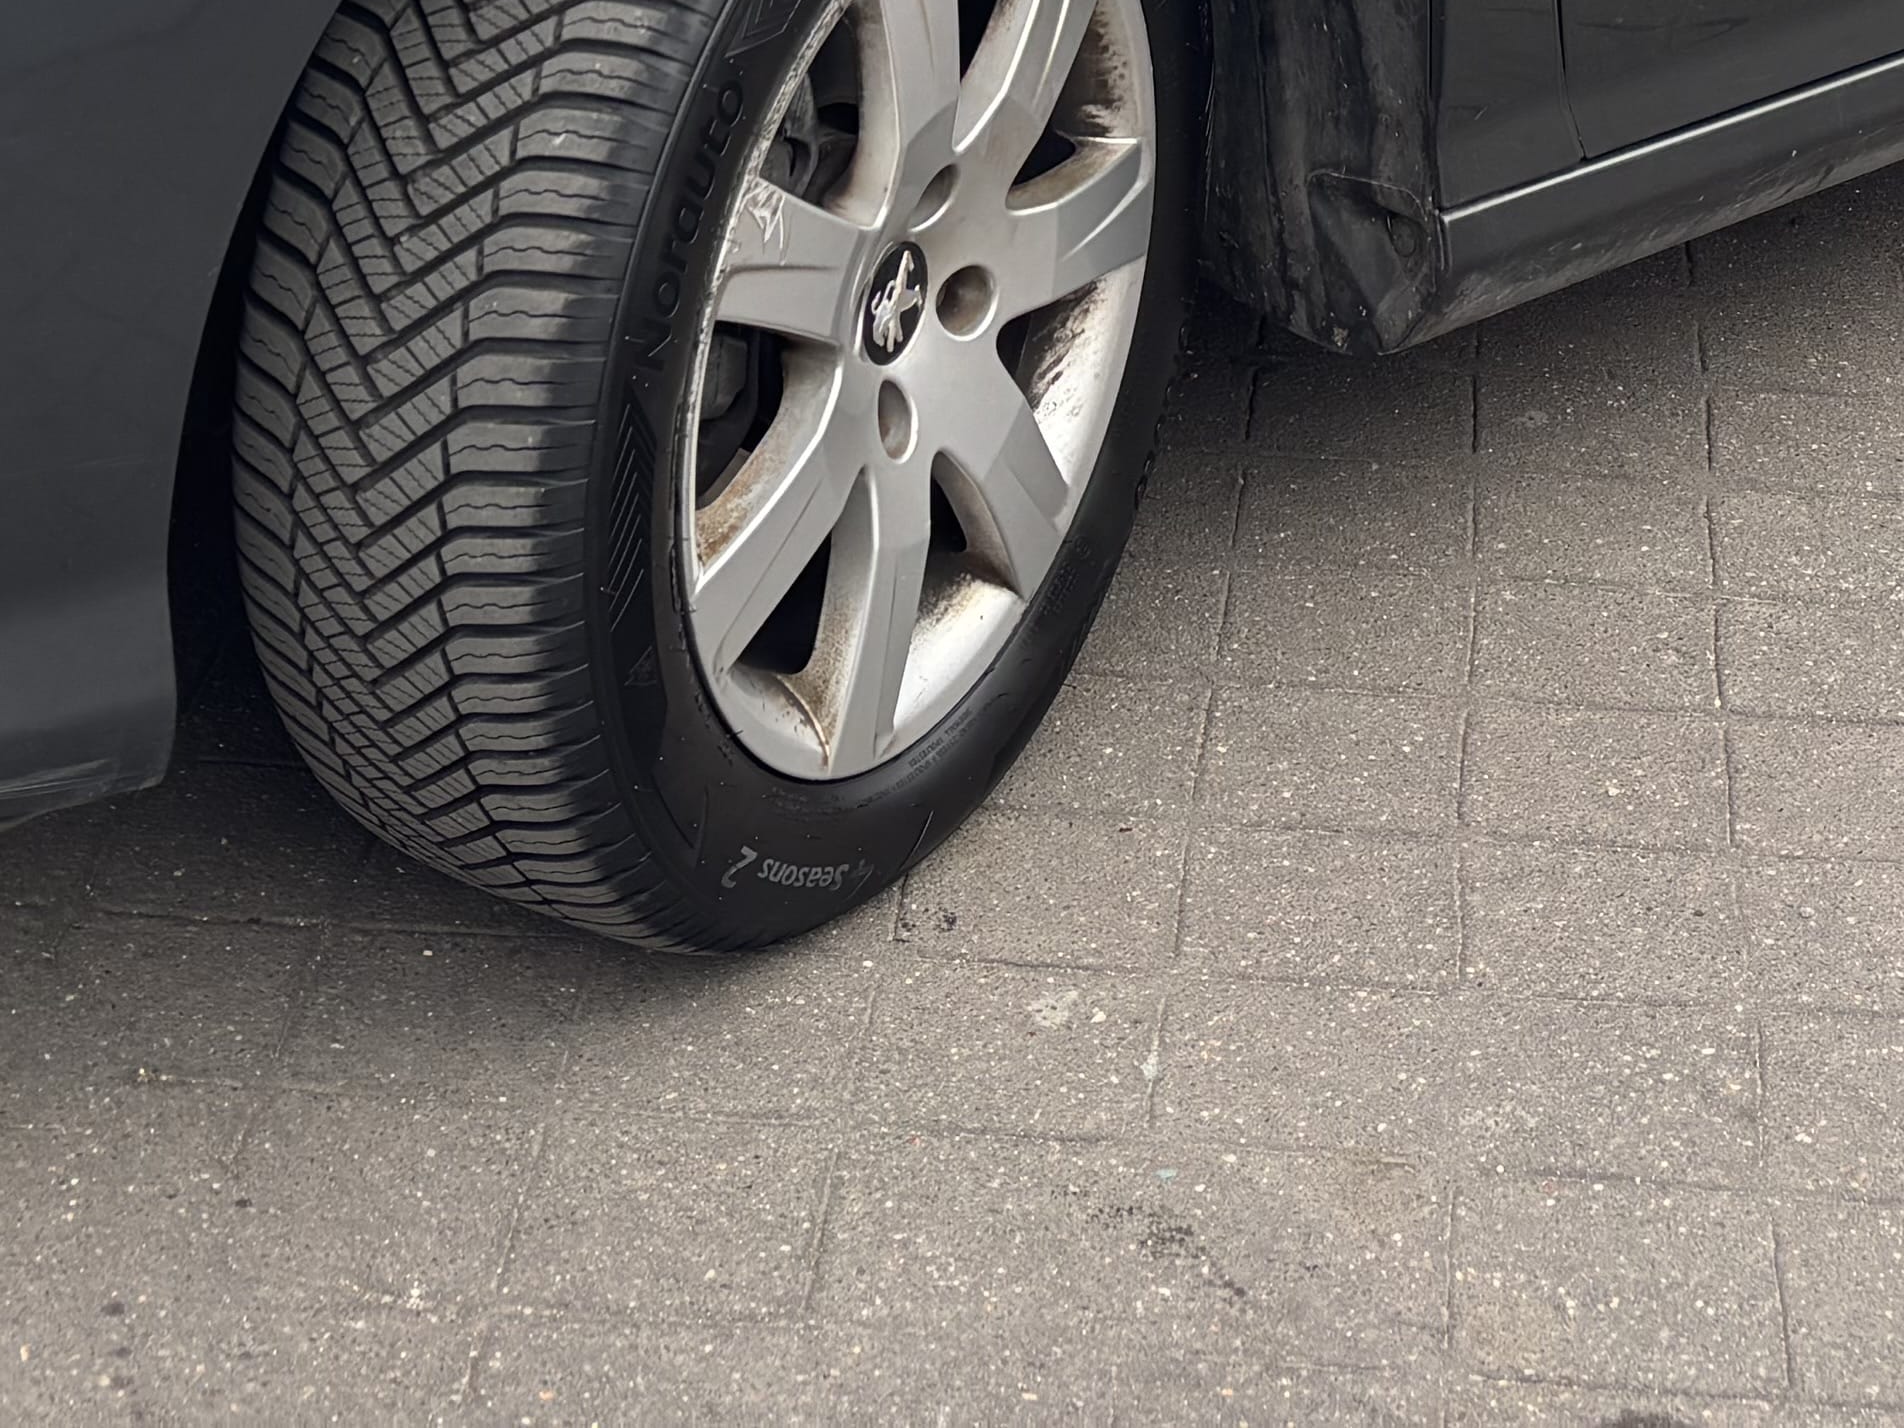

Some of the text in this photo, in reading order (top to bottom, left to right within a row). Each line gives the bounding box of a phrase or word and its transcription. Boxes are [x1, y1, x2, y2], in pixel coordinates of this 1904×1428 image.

[636, 78, 744, 374] Norauto
[720, 845, 758, 890] 2
[757, 857, 850, 891] Seasons
